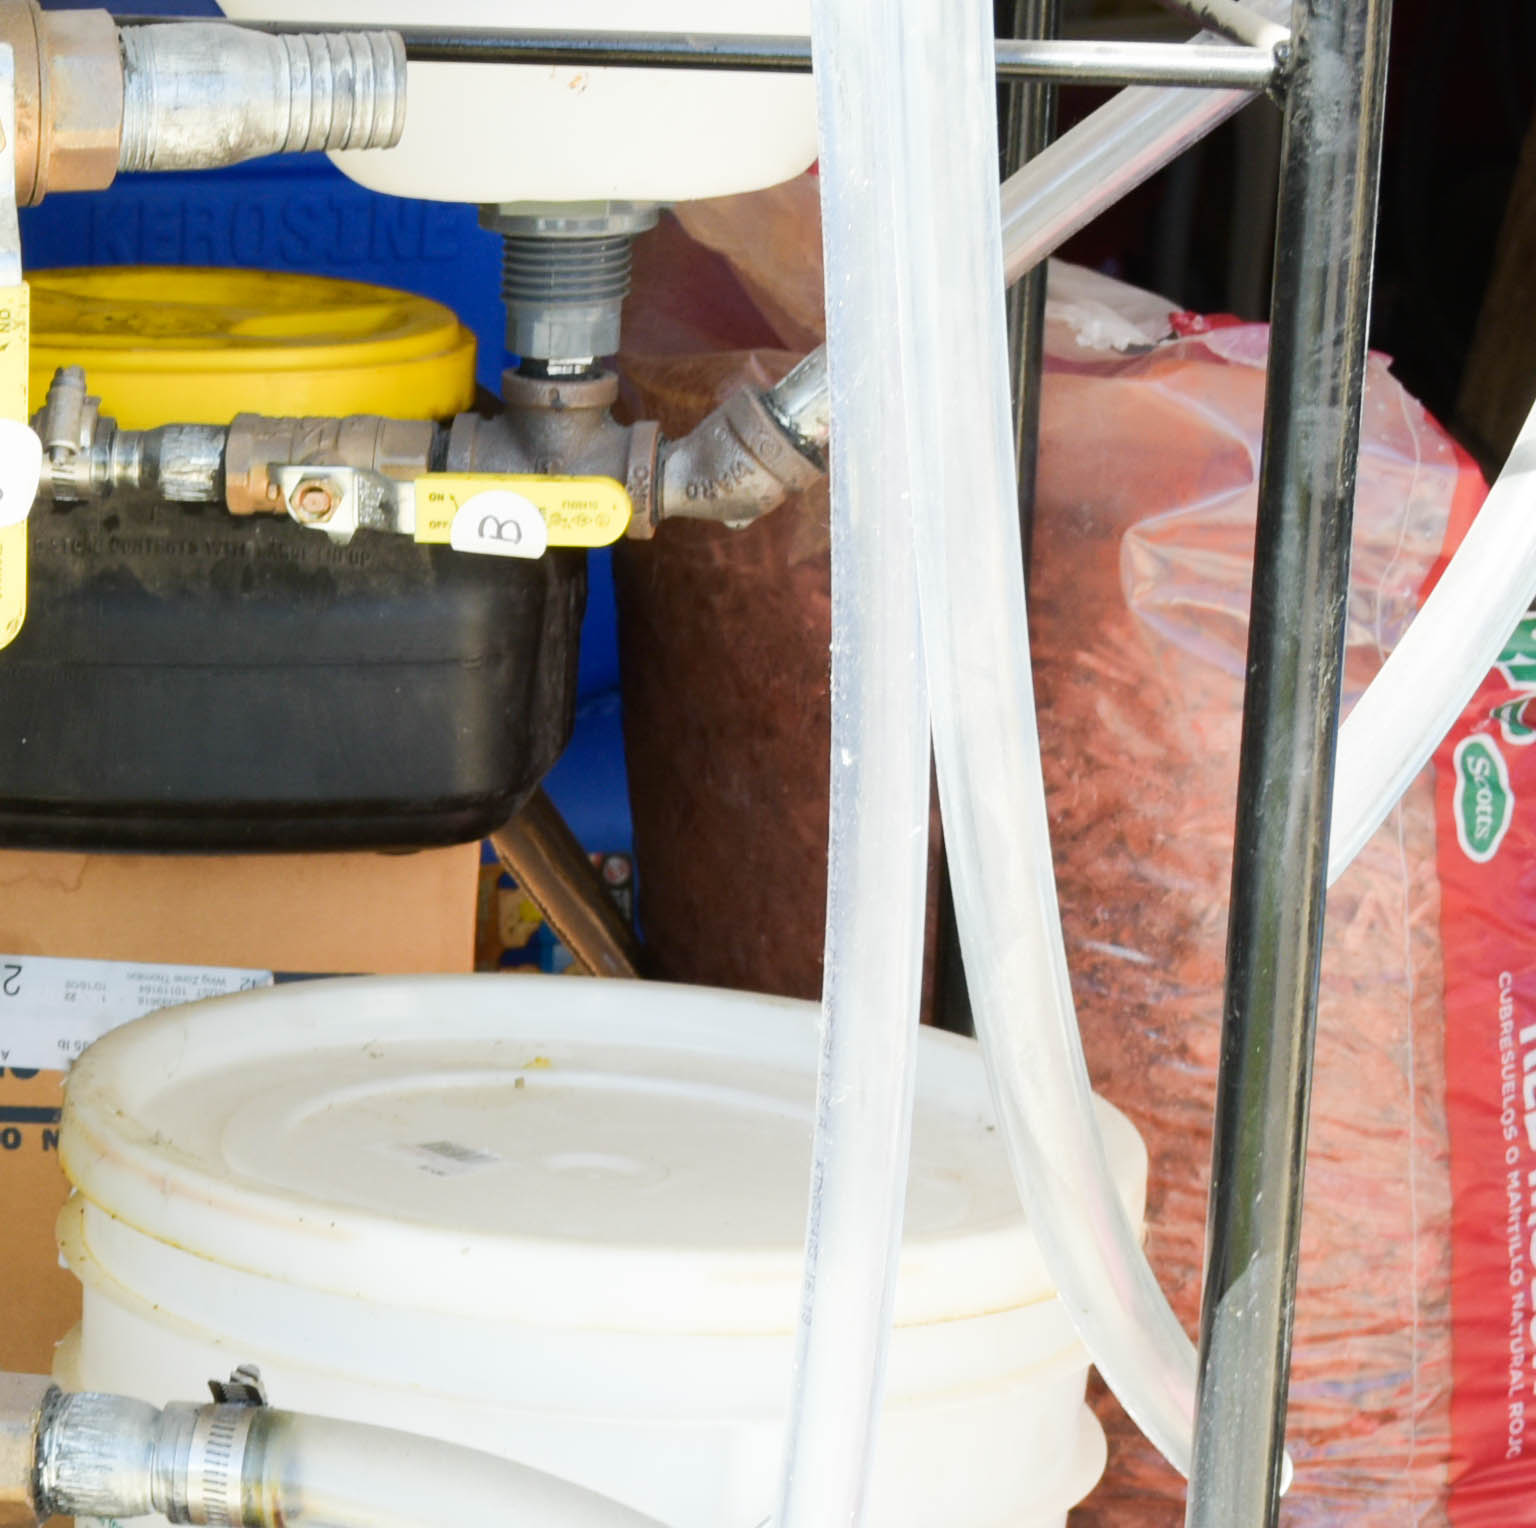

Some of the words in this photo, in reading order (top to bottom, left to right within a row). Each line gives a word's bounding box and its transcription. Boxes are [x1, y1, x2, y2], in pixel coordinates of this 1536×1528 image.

[88, 198, 461, 266] KEROSINE
[0, 309, 11, 335] ON
[429, 492, 446, 503] ON
[429, 519, 449, 530] OFF
[479, 513, 524, 547] B
[1466, 754, 1494, 841] Scotts
[2, 964, 23, 997] 2
[1498, 970, 1519, 1133] CUBRESUELOS
[1504, 1146, 1519, 1165] O
[1505, 1170, 1524, 1285] MANTILLO
[1507, 1291, 1525, 1395] NATURAL
